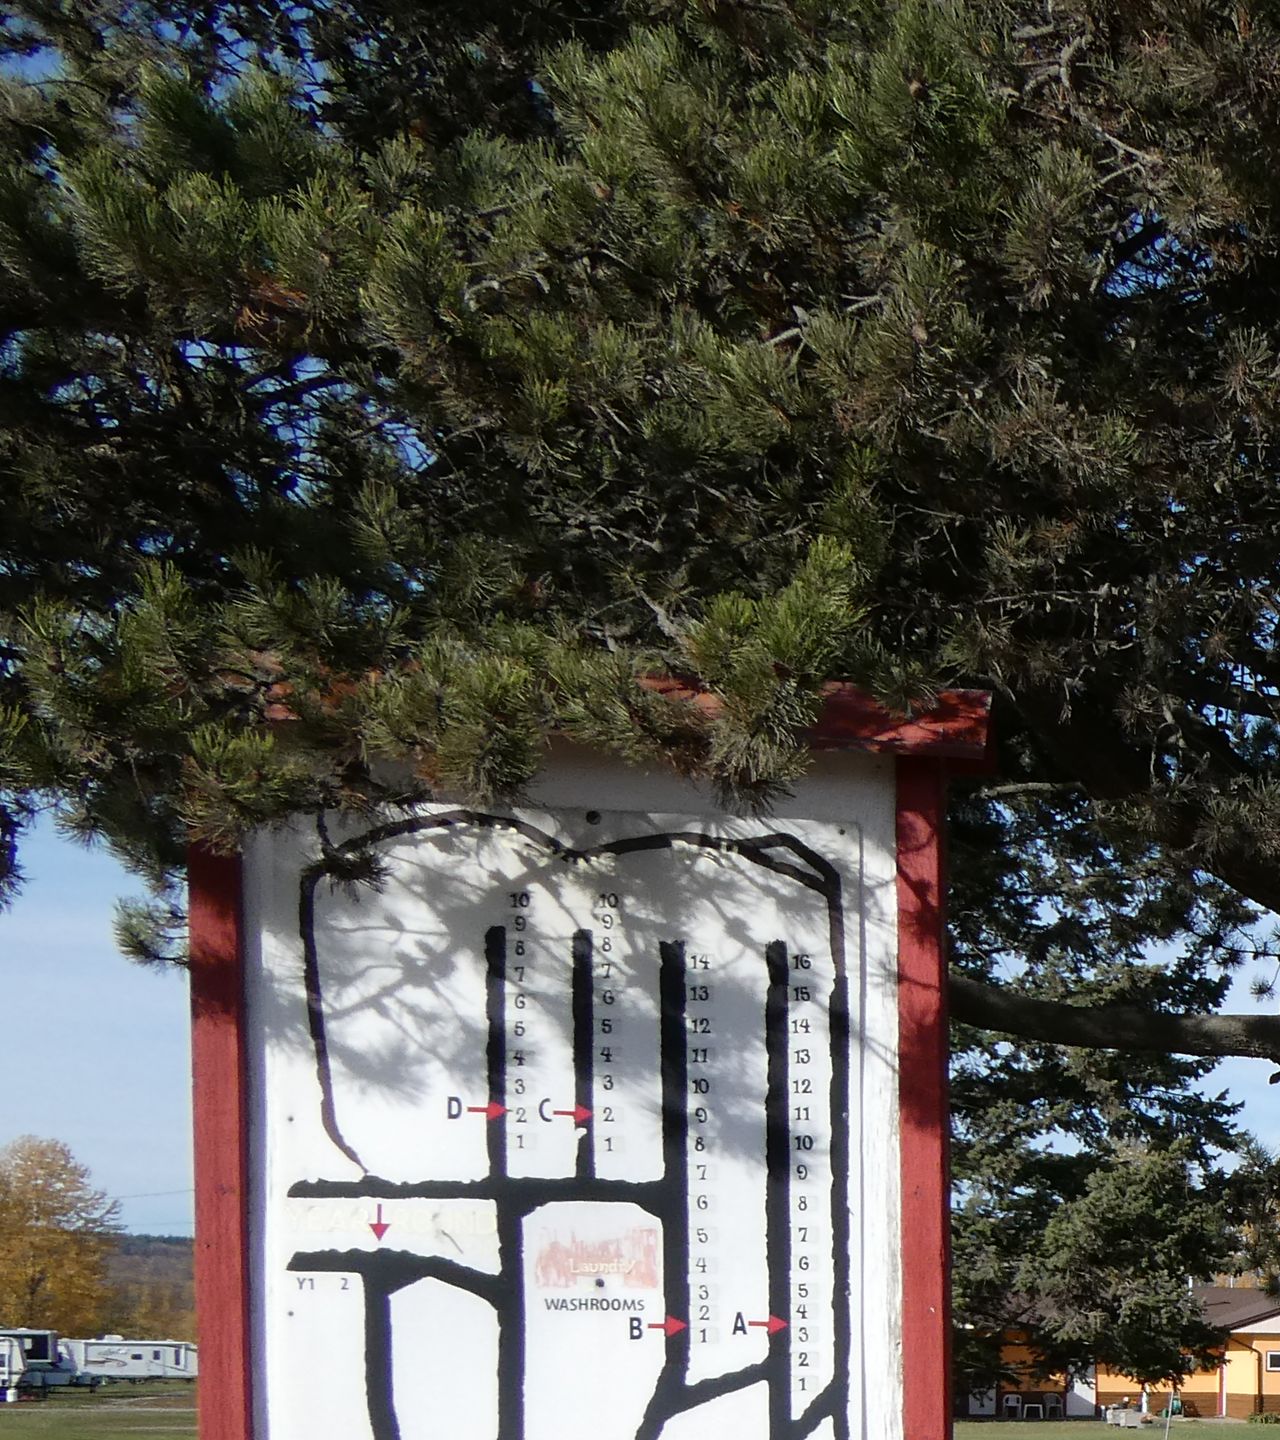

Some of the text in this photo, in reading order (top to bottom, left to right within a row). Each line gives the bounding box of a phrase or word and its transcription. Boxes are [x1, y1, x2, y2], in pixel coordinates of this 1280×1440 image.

[510, 893, 530, 908] 10
[599, 893, 619, 908] 10
[514, 916, 526, 931] 9
[602, 914, 613, 929] 9
[515, 941, 526, 956] 8
[602, 937, 612, 952] 8
[691, 954, 710, 970] 14
[792, 954, 811, 970] 16
[514, 967, 525, 982] 7
[602, 964, 612, 978] 7
[603, 990, 615, 1004] 6
[690, 986, 709, 1000] 13
[793, 987, 810, 1001] 15
[514, 994, 526, 1009] 6
[514, 1021, 525, 1036] 5
[602, 1018, 613, 1033] 5
[691, 1019, 711, 1034] 12
[791, 1018, 810, 1033] 14
[513, 1052, 526, 1066] 4
[600, 1048, 613, 1063] 4
[692, 1049, 708, 1063] 11
[794, 1049, 810, 1064] 13
[515, 1079, 526, 1094] 3
[603, 1075, 614, 1090] 3
[692, 1079, 710, 1094] 10
[793, 1079, 812, 1094] 12
[448, 1097, 462, 1119] D
[516, 1107, 527, 1123] 2
[538, 1098, 552, 1123] C
[603, 1107, 615, 1122] 2
[695, 1108, 707, 1123] 9
[794, 1107, 810, 1121] 11
[516, 1135, 525, 1149] 1
[604, 1138, 614, 1152] 1
[695, 1137, 705, 1152] 8
[794, 1135, 813, 1150] 10
[697, 1165, 707, 1181] 7
[797, 1164, 807, 1180] 9
[697, 1195, 708, 1210] 6
[798, 1196, 807, 1211] 8
[697, 1229, 708, 1243] 5
[798, 1227, 807, 1242] 7
[696, 1257, 707, 1273] 4
[799, 1256, 809, 1270] 6
[297, 1278, 349, 1290] Y1 2
[798, 1283, 808, 1298] 5
[699, 1285, 709, 1300] 3
[545, 1298, 645, 1311] WASHROOMS
[796, 1304, 807, 1319] 4
[699, 1306, 710, 1320] 2
[629, 1317, 643, 1340] B
[732, 1312, 747, 1335] A
[700, 1329, 707, 1343] 1
[799, 1327, 809, 1342] 3
[798, 1352, 809, 1366] 2
[799, 1378, 808, 1391] 1
